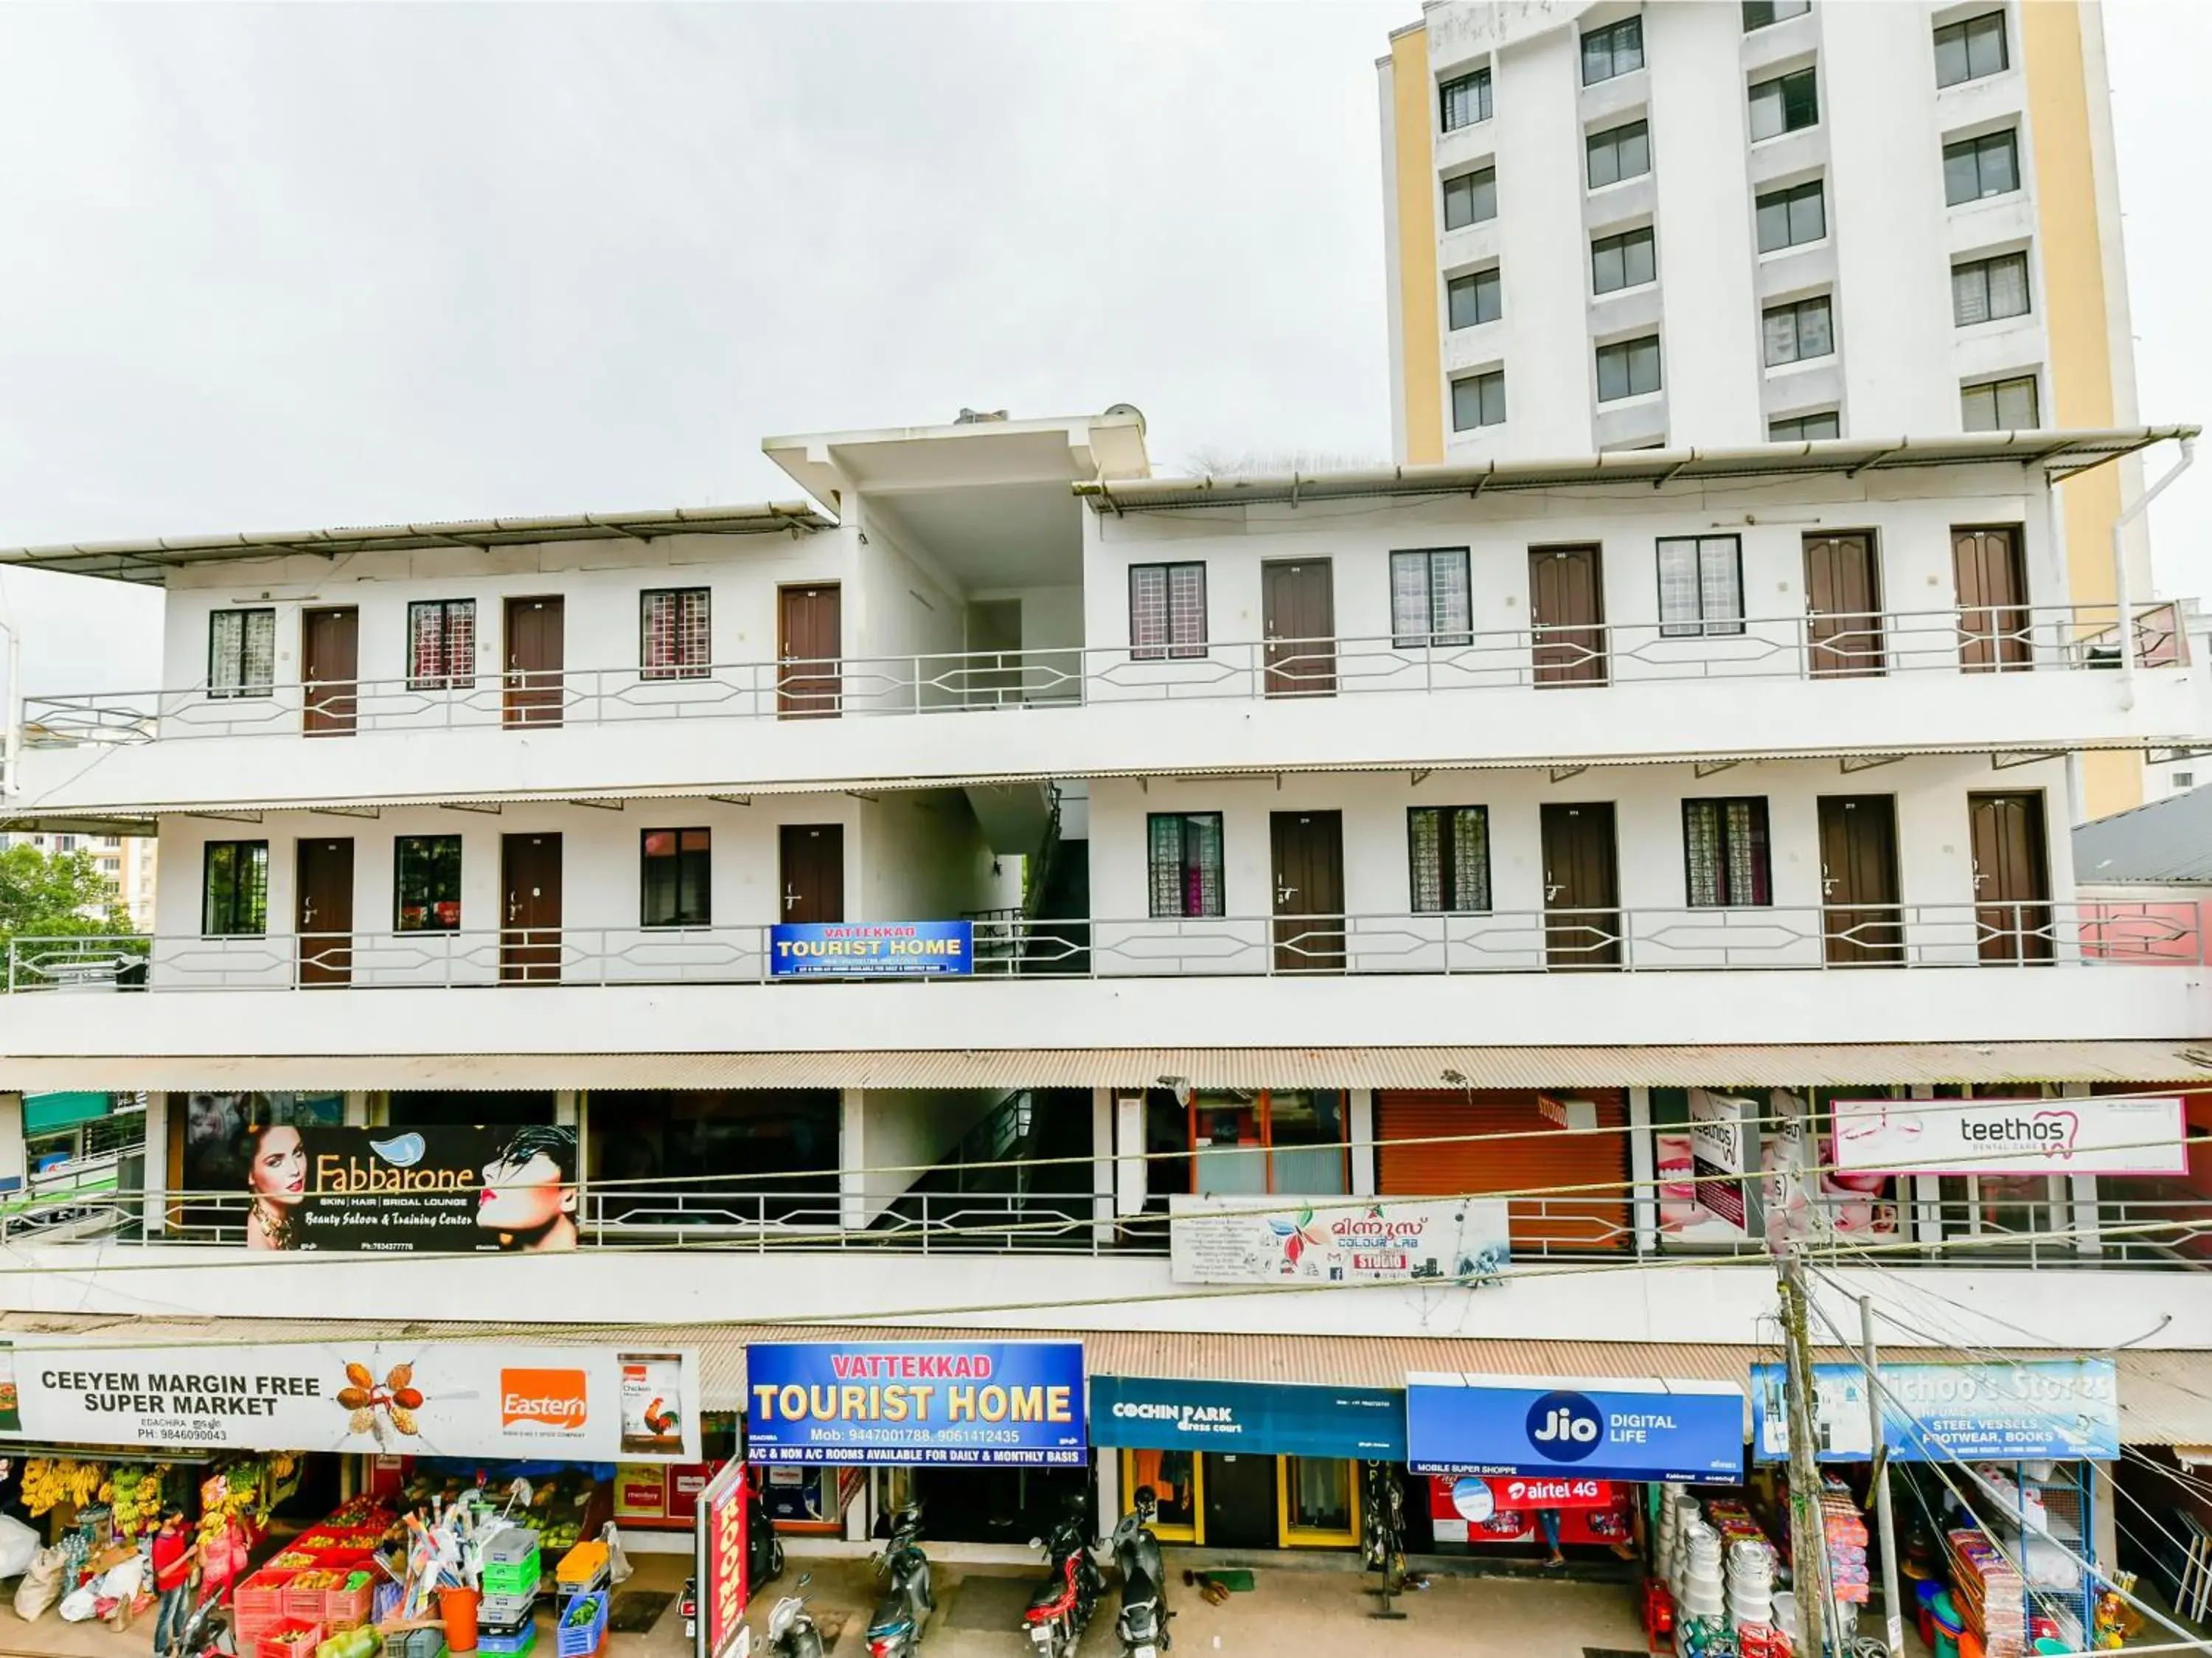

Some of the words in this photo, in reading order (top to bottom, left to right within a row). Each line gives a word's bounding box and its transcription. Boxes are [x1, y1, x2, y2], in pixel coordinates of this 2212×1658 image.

[824, 926, 916, 938] VATTEKKAD
[777, 940, 883, 957] TOURIST
[891, 939, 962, 956] HOME
[1961, 1117, 2064, 1140] teethos
[316, 1154, 474, 1193] Fabbarone
[319, 1198, 346, 1206] SKIN
[383, 1198, 421, 1206] BRIDAL
[424, 1198, 467, 1206] LOUNGE
[305, 1212, 340, 1227] Beauty
[380, 1213, 389, 1226] &
[392, 1211, 437, 1227] Training
[439, 1211, 473, 1225] Center
[1338, 1237, 1388, 1248] COLOUR
[1393, 1238, 1419, 1248] LAB
[1359, 1255, 1402, 1268] STUDIO
[831, 1354, 992, 1380] VATTEKKAD
[41, 1370, 140, 1392] CEEYEM
[148, 1373, 246, 1394] MARGIN
[255, 1376, 321, 1397] FREE
[1879, 1367, 2000, 1403] ichoo's
[85, 1393, 164, 1414] SUPER
[173, 1396, 278, 1417] MARKET
[504, 1392, 585, 1417] Eastern
[753, 1384, 935, 1423] TOURIST
[948, 1385, 1072, 1423] HOME
[1112, 1401, 1179, 1421] COCHIN
[1182, 1405, 1233, 1423] PARK
[1177, 1418, 1211, 1432] dress
[1213, 1422, 1242, 1434] court
[1534, 1407, 1598, 1443] Jio
[1610, 1413, 1677, 1429] DIGITAL
[1933, 1419, 1975, 1431] STEEL
[138, 1429, 158, 1440] PH:
[160, 1429, 227, 1440] 9846090043
[810, 1428, 845, 1440] Mob:
[1610, 1429, 1647, 1443] LIFE
[2005, 1432, 2054, 1443] BOOKS
[748, 1448, 767, 1460] A/C
[769, 1448, 778, 1460] &
[780, 1448, 802, 1460] NON
[804, 1448, 823, 1460] A/C
[825, 1448, 865, 1460] ROOMS
[866, 1449, 922, 1461] AVAILABLE
[925, 1449, 947, 1460] FOR
[949, 1450, 979, 1462] DAILY
[982, 1450, 991, 1461] &
[993, 1450, 1044, 1463] MONTHLY
[1046, 1451, 1079, 1463] BASIS
[1417, 1463, 1450, 1473] MOBILE
[1451, 1464, 1480, 1474] SUPER
[1481, 1466, 1517, 1475] SHOPPE
[1527, 1482, 1571, 1499] airtel
[1572, 1481, 1599, 1497] 4G
